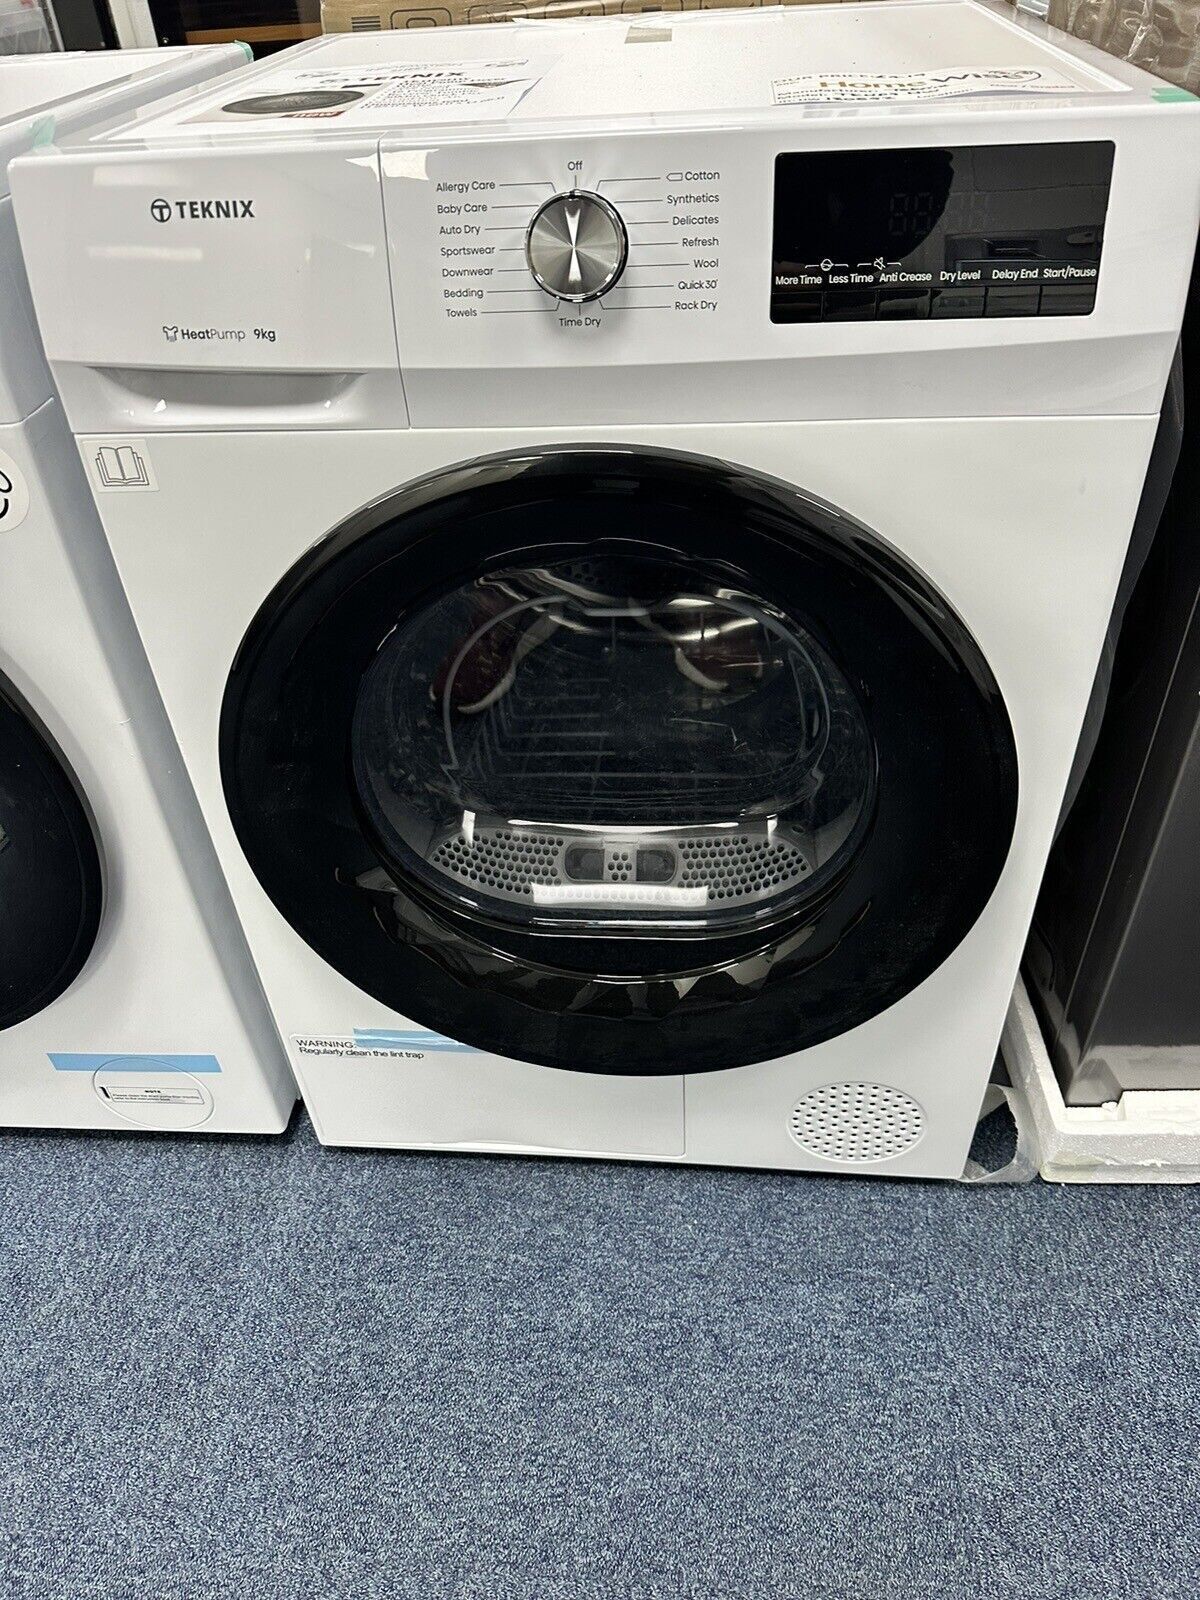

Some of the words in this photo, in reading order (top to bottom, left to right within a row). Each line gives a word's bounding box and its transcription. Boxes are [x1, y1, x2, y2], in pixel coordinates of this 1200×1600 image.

[359, 71, 465, 81] TEKNIX
[567, 160, 583, 171] Off
[684, 170, 720, 181] Cotton
[436, 181, 469, 193] Allergy
[471, 180, 496, 191] Care
[667, 193, 720, 206] Synthetics
[175, 200, 255, 219] TEKNIX
[437, 204, 462, 215] Baby
[464, 203, 488, 213] Care
[672, 215, 720, 226] Delicates
[439, 226, 462, 235] Auto
[464, 225, 481, 236] Dry
[682, 236, 719, 247] Refresh
[440, 247, 495, 258] Sportswear
[693, 258, 719, 268] Wool
[442, 267, 494, 277] Downwear
[879, 272, 898, 282] Anti
[899, 271, 932, 282] Crease
[940, 271, 956, 283] Dry
[957, 270, 981, 280] Level
[992, 269, 1019, 281] Delay
[1020, 268, 1039, 279] End
[1043, 265, 1097, 279] Start/Pause
[775, 275, 798, 285] More
[800, 274, 822, 284] Time
[828, 274, 849, 284] Less
[850, 273, 874, 283] Time
[444, 288, 484, 299] Bedding
[675, 300, 698, 310] Rack
[701, 299, 718, 311] Dry
[446, 307, 477, 317] Towels
[559, 317, 583, 327] Time
[585, 316, 602, 328] Dry
[181, 328, 246, 342] HeatPump
[253, 328, 277, 342] 9kg
[296, 1039, 357, 1049] WARNING:
[299, 1047, 344, 1057] Regularly
[345, 1048, 372, 1057] clean
[406, 1051, 424, 1059] trap
